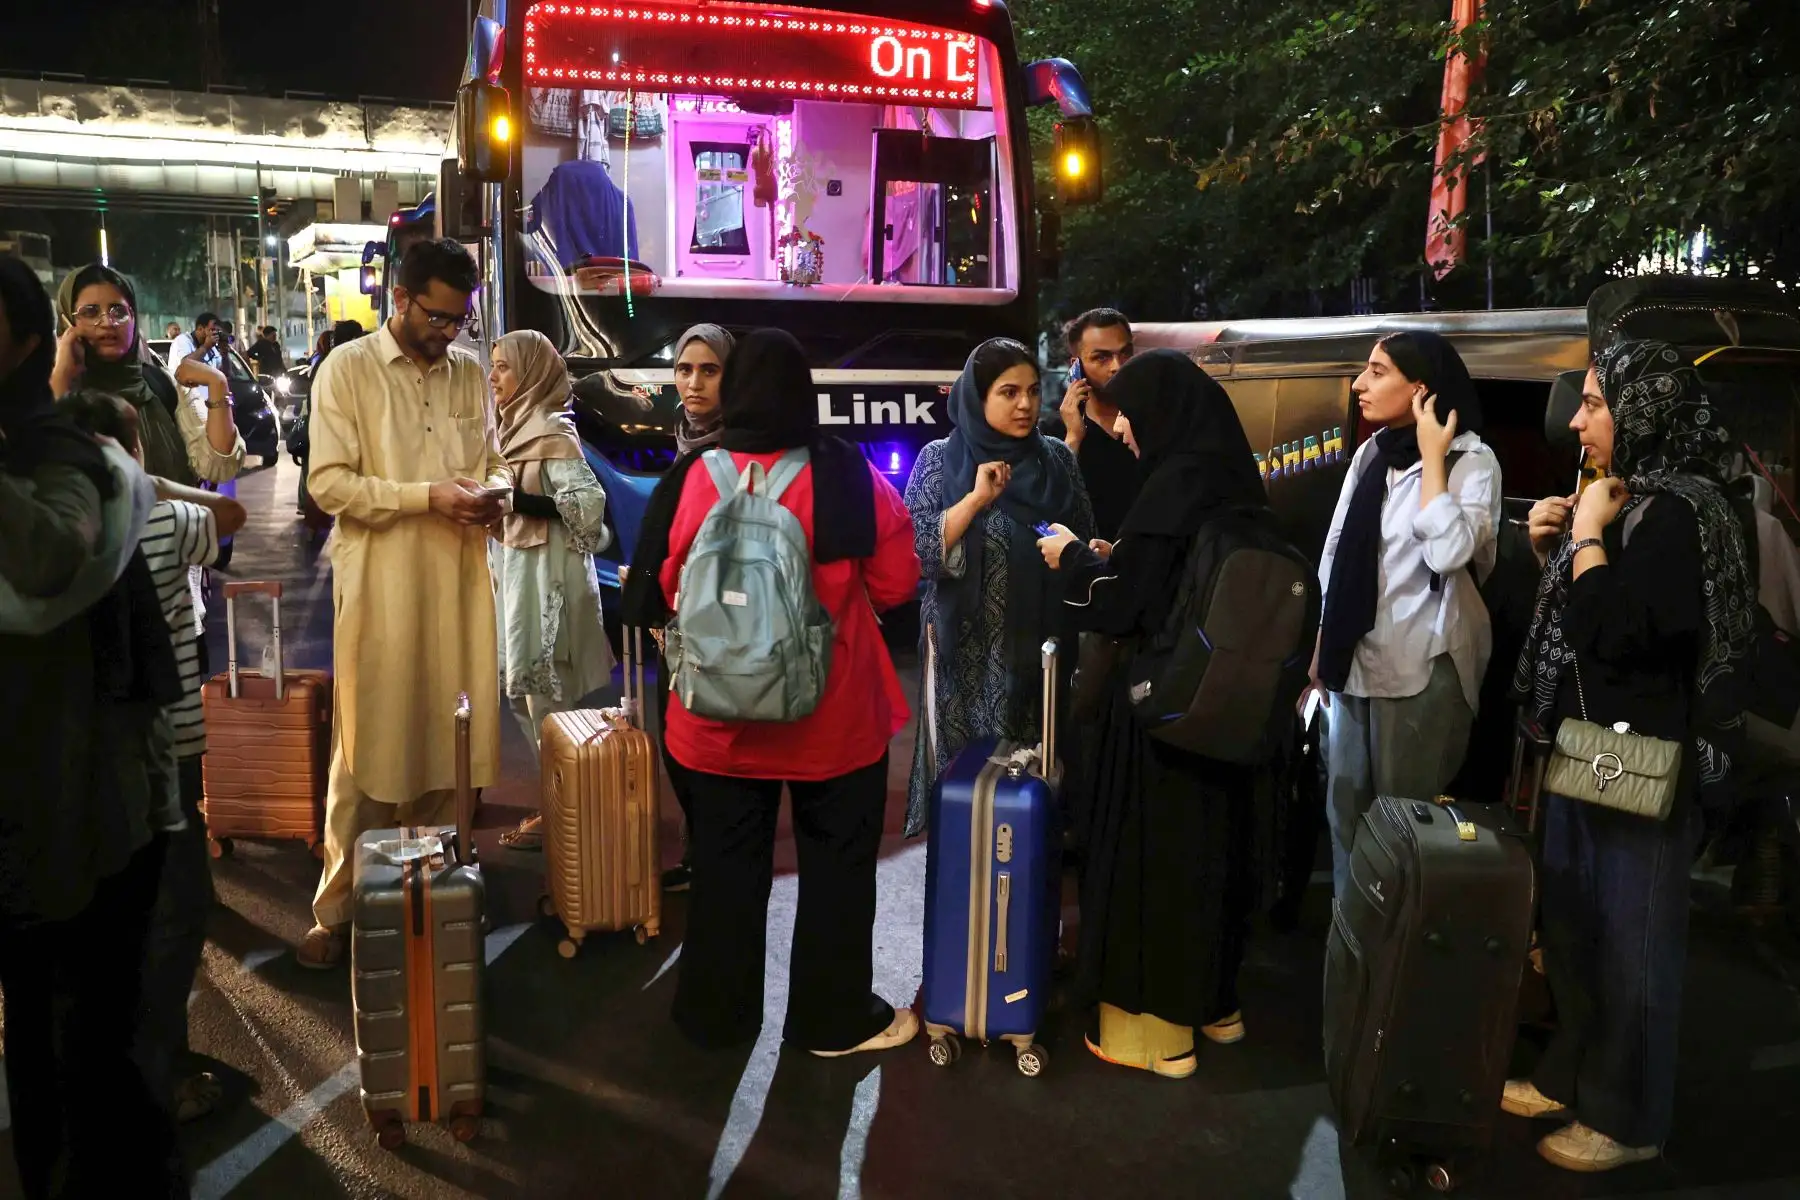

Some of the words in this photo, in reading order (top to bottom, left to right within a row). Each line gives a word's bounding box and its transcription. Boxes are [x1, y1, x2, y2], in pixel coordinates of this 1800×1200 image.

[870, 35, 931, 79] On
[674, 100, 748, 115] WELCO
[817, 393, 937, 425] Link
